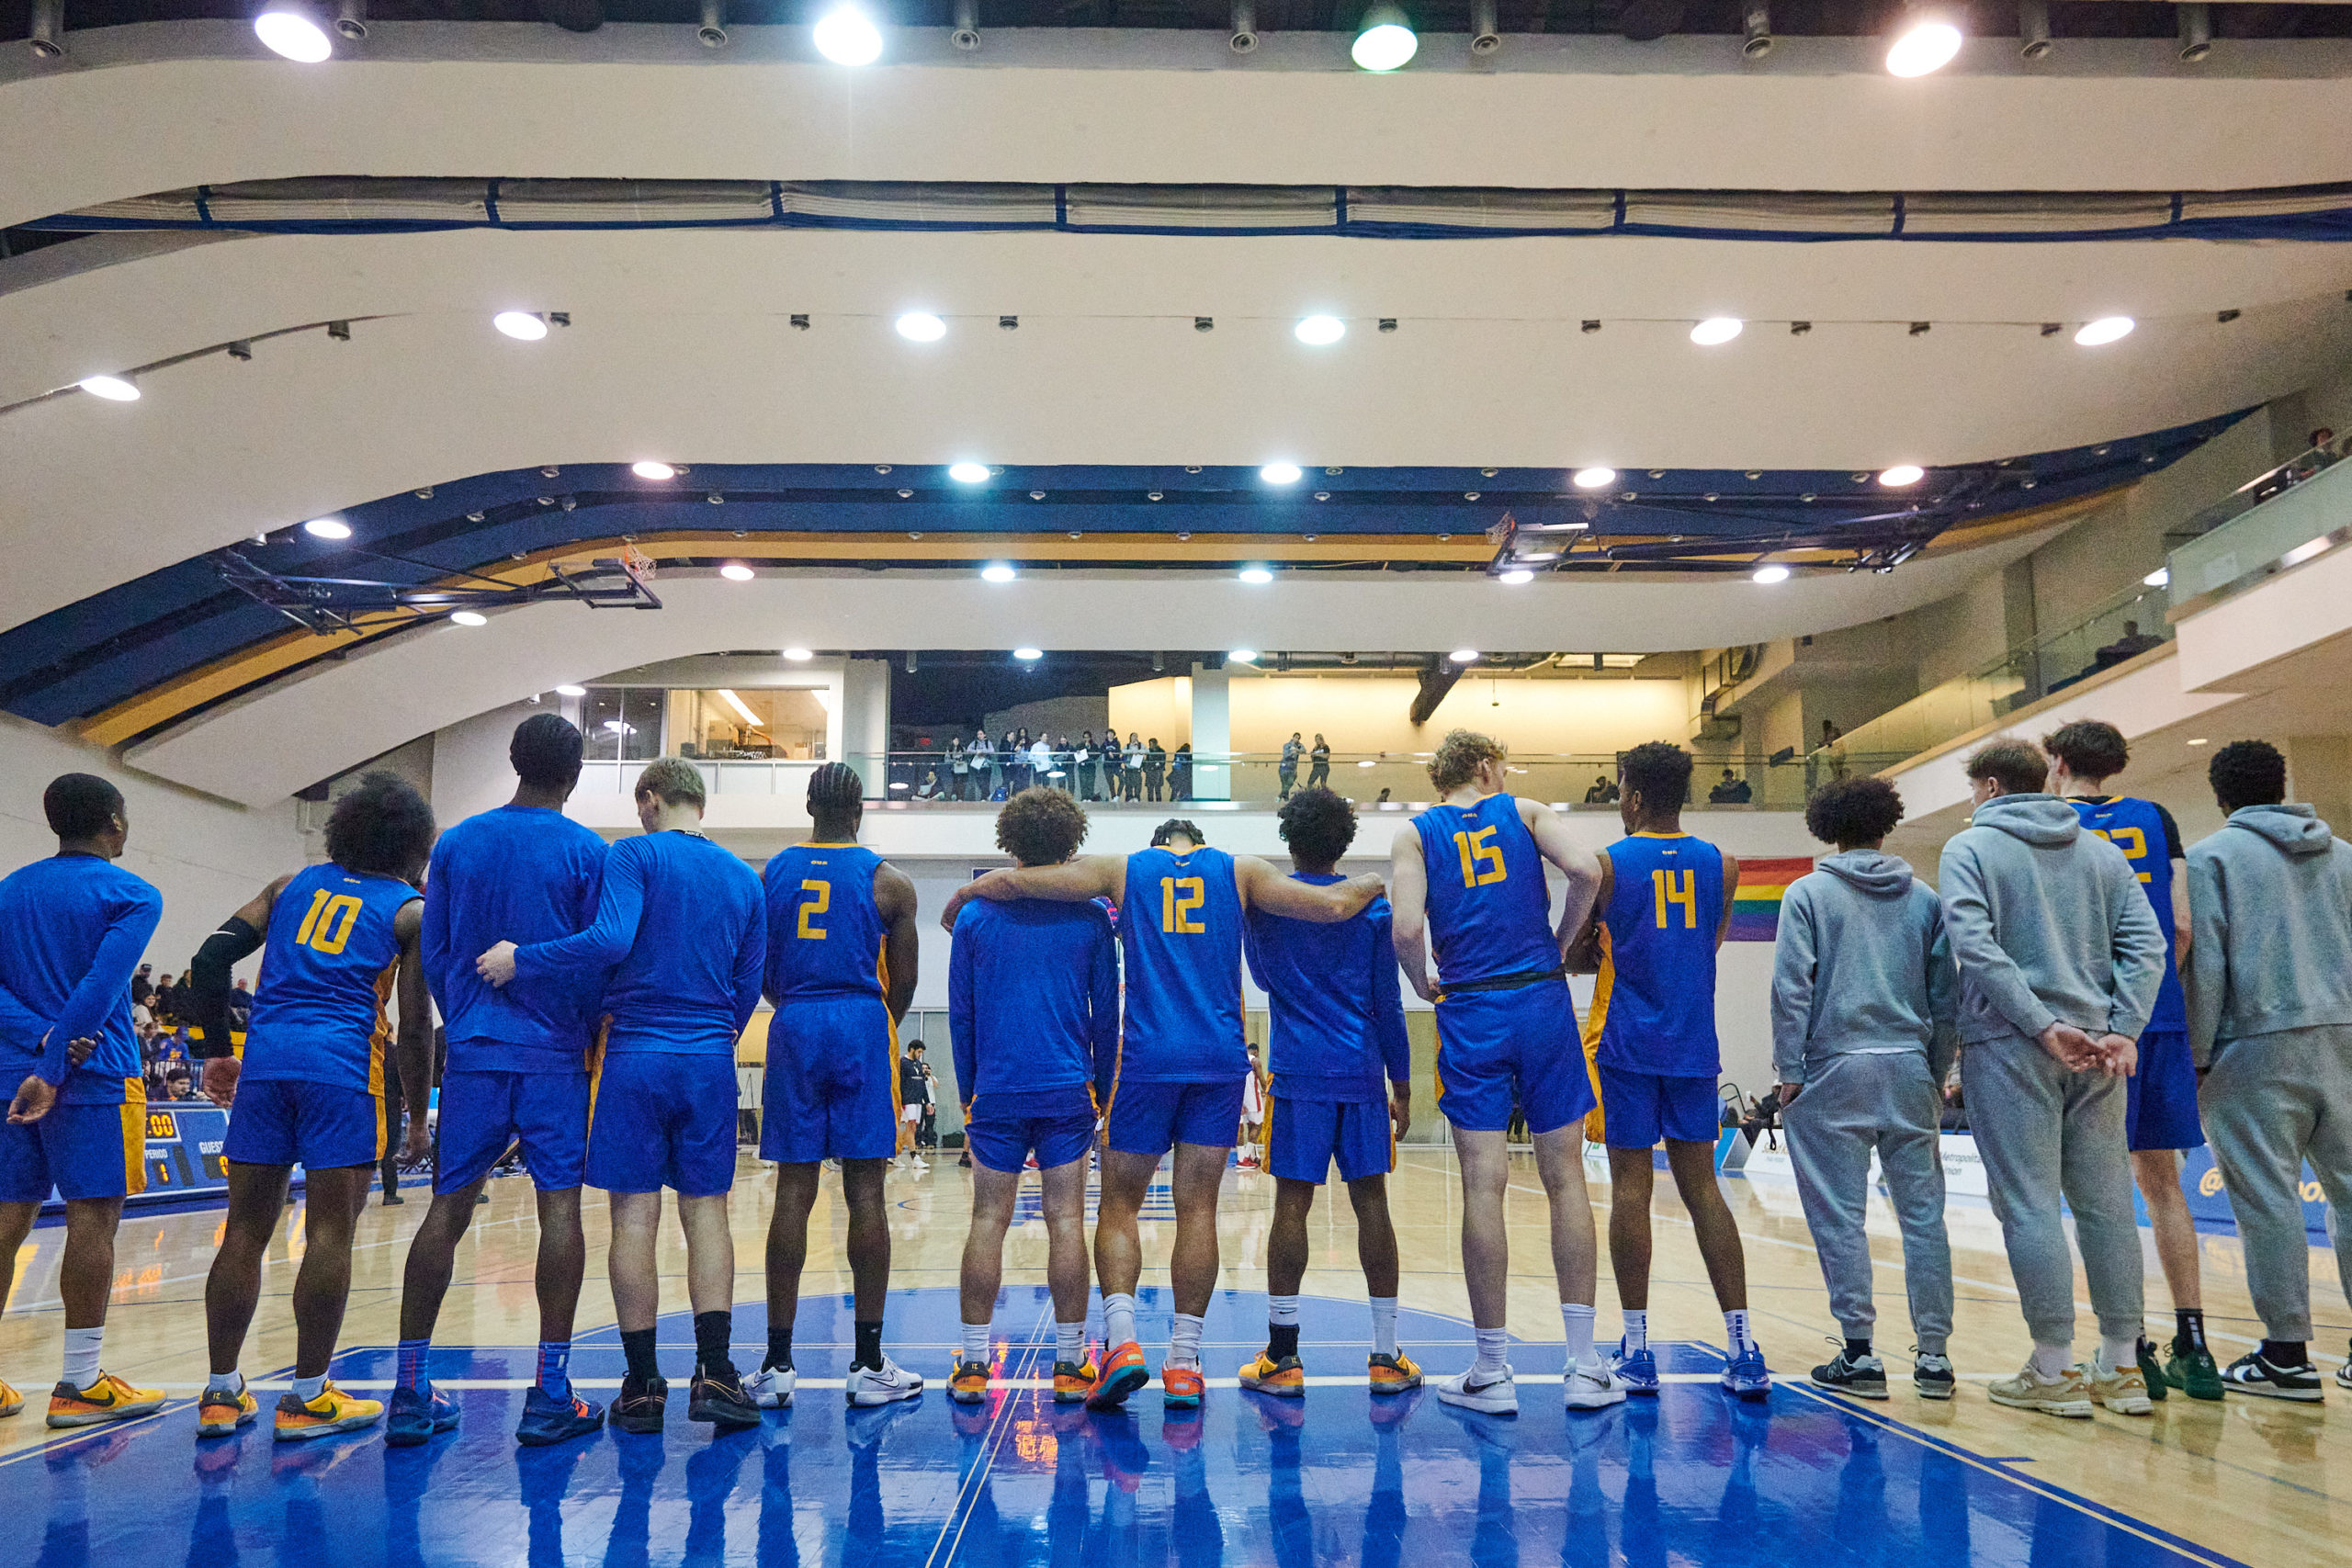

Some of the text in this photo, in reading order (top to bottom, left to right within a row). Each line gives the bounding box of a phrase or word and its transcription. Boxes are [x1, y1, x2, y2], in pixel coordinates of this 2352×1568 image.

[1453, 824, 1507, 888] 15
[2089, 827, 2152, 884] 2
[295, 888, 363, 954] 10
[797, 879, 831, 940] 2
[1160, 876, 1205, 933] 12
[1652, 869, 1696, 929] 14
[145, 1148, 168, 1159] PERIOD
[161, 1163, 169, 1182] 1
[198, 1141, 224, 1155] GUEST
